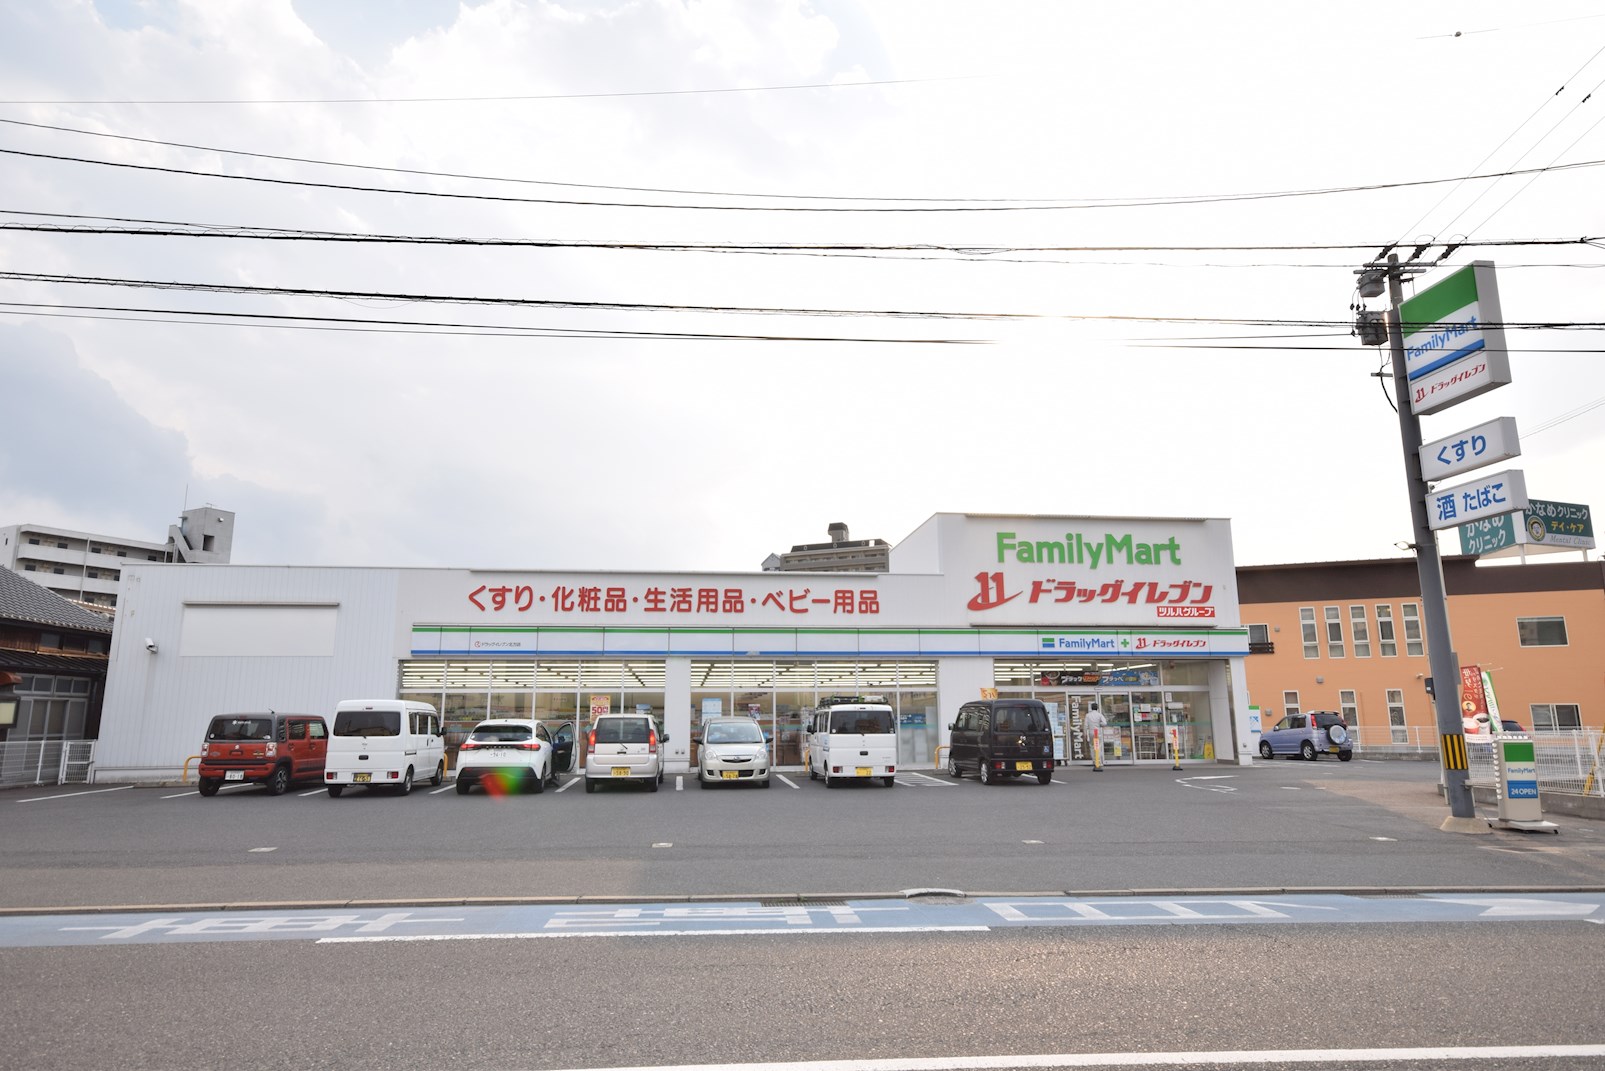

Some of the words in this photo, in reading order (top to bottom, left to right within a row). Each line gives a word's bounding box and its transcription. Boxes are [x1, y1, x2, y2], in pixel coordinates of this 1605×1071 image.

[1431, 363, 1486, 394] ドラッグイレブン
[1437, 435, 1487, 466] くすり
[1436, 493, 1457, 521] 酒
[1462, 482, 1506, 512] たばこ
[996, 531, 1181, 569] FamilyMart
[1468, 529, 1506, 554] クリニック
[468, 585, 880, 615] くすり・化粧品・生活用品・ベビー用品
[1029, 579, 1213, 604] ドラッグイレブン
[1158, 607, 1214, 617] ツルハグループ
[1059, 638, 1115, 649] FamilyMart
[1153, 639, 1207, 648] ドラッグイレブン
[1071, 695, 1084, 759] FamilyMart
